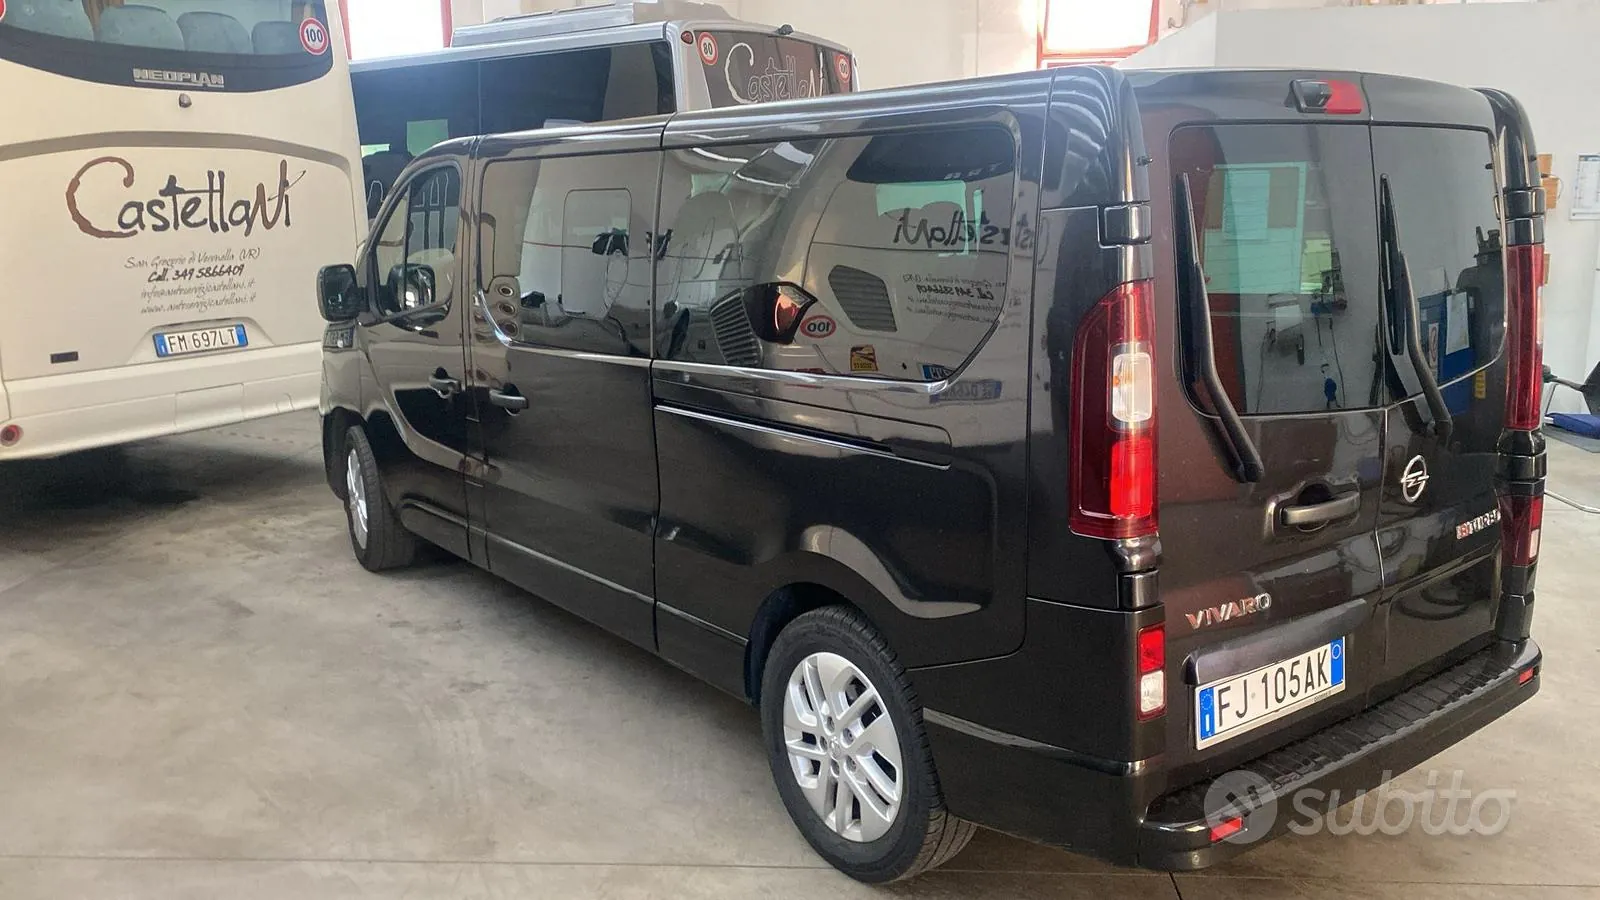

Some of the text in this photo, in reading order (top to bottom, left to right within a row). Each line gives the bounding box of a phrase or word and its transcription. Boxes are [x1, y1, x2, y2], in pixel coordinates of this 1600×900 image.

[305, 28, 324, 43] 100
[703, 42, 713, 56] 80
[133, 68, 224, 87] NEOPLAN
[124, 256, 148, 269] San
[239, 247, 260, 261] (VR)
[172, 268, 195, 281] 349
[196, 263, 245, 279] 5866409
[167, 328, 236, 352] FM 697LT
[1185, 592, 1271, 629] VIVARO
[1218, 648, 1328, 727] FJ 105AK
